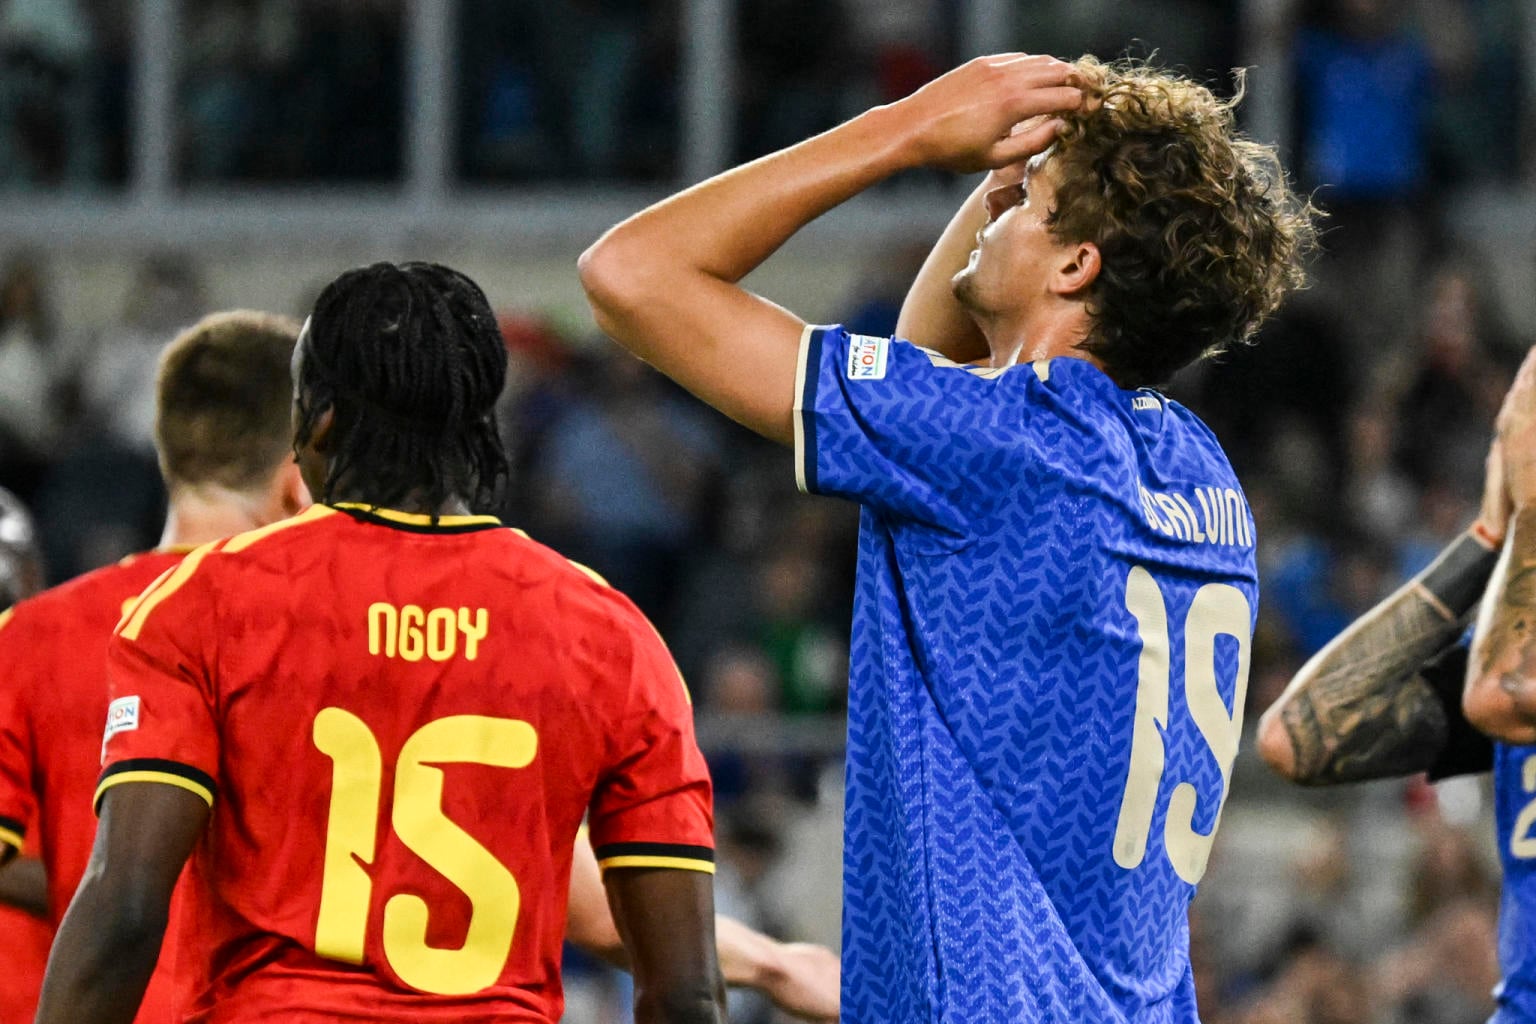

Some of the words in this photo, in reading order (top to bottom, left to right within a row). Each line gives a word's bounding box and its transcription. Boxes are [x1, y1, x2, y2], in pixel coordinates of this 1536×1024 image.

[368, 602, 488, 661] NGOY
[1113, 566, 1251, 885] 19
[312, 706, 538, 995] 15
